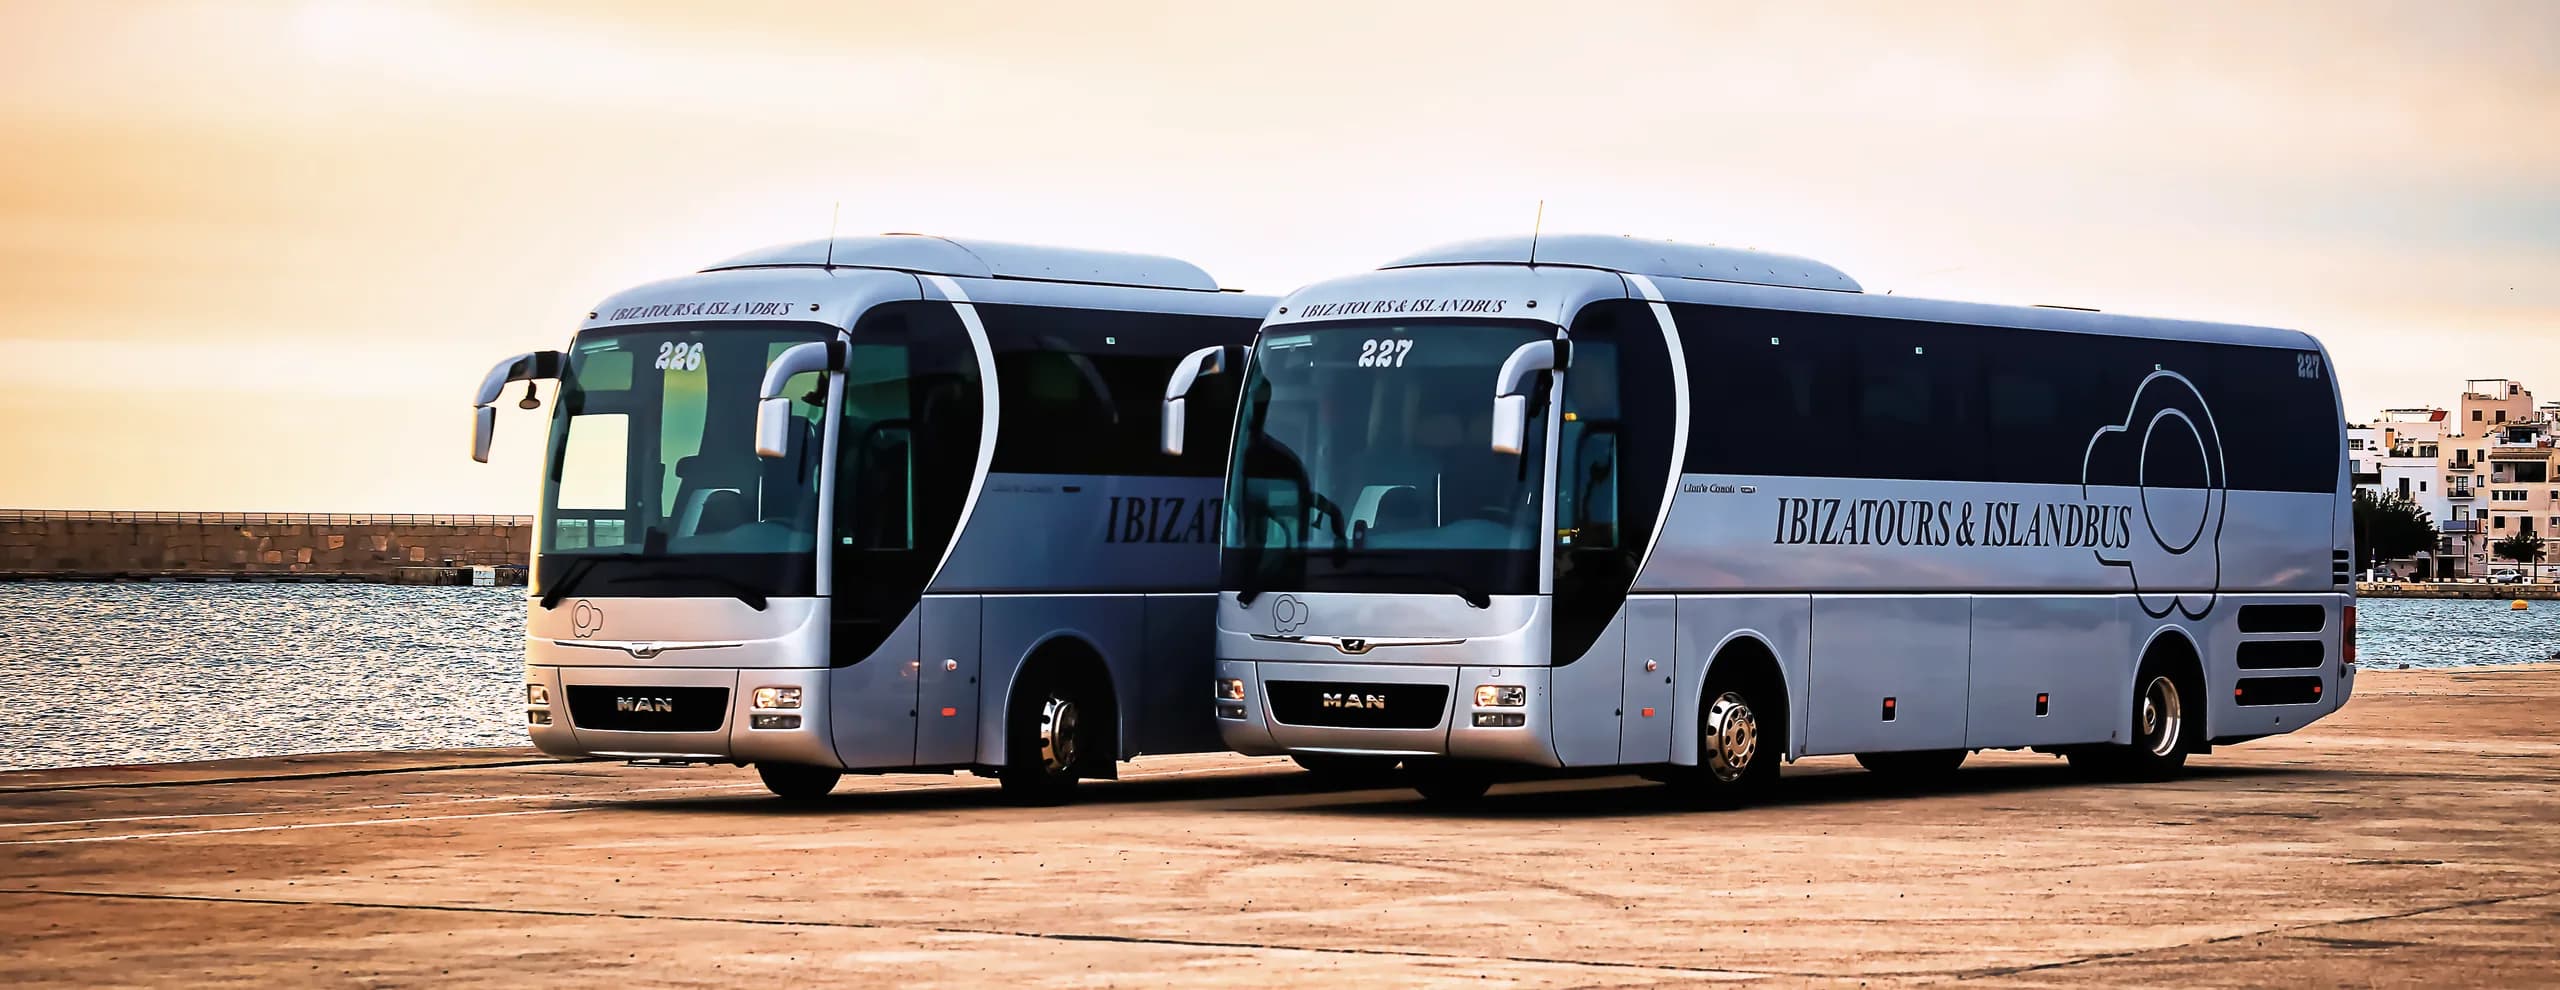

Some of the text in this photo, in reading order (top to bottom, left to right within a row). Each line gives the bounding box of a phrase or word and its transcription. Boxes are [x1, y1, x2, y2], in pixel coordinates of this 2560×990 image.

[610, 302, 695, 321] IBIZATOURS
[705, 302, 794, 316] ISLANDBUS
[1301, 299, 1507, 318] IBIZATOURS & ISLANDBUS
[655, 341, 704, 371] 226
[1358, 338, 1414, 368] 227
[2297, 353, 2320, 379] 227
[1773, 497, 2133, 548] IBIZATOURS & ISLANDBUS
[617, 697, 673, 712] MAN
[1323, 693, 1385, 709] MAN
